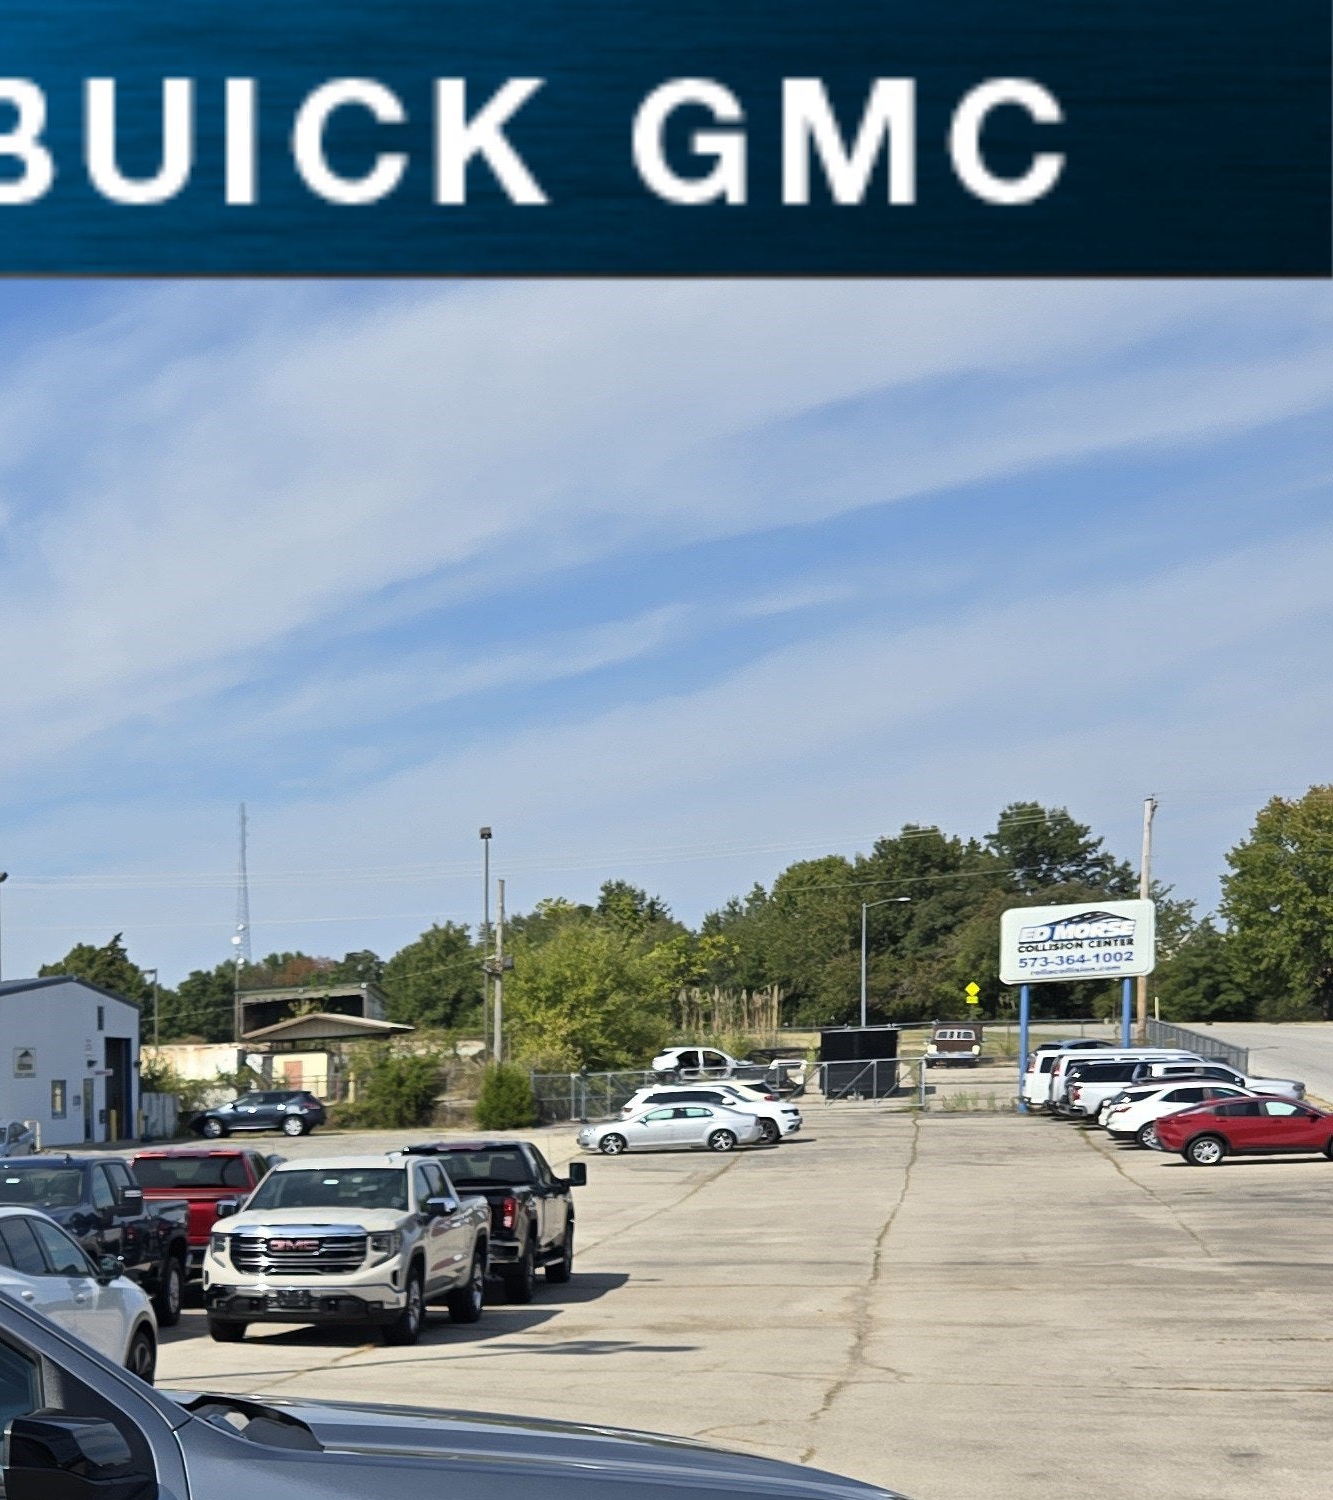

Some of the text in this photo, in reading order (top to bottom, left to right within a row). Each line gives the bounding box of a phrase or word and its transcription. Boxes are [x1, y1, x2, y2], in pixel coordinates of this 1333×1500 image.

[1019, 919, 1136, 944] ED MORSE
[1017, 938, 1134, 953] COLLISION CENTER
[1018, 951, 1134, 968] 573-364-1002
